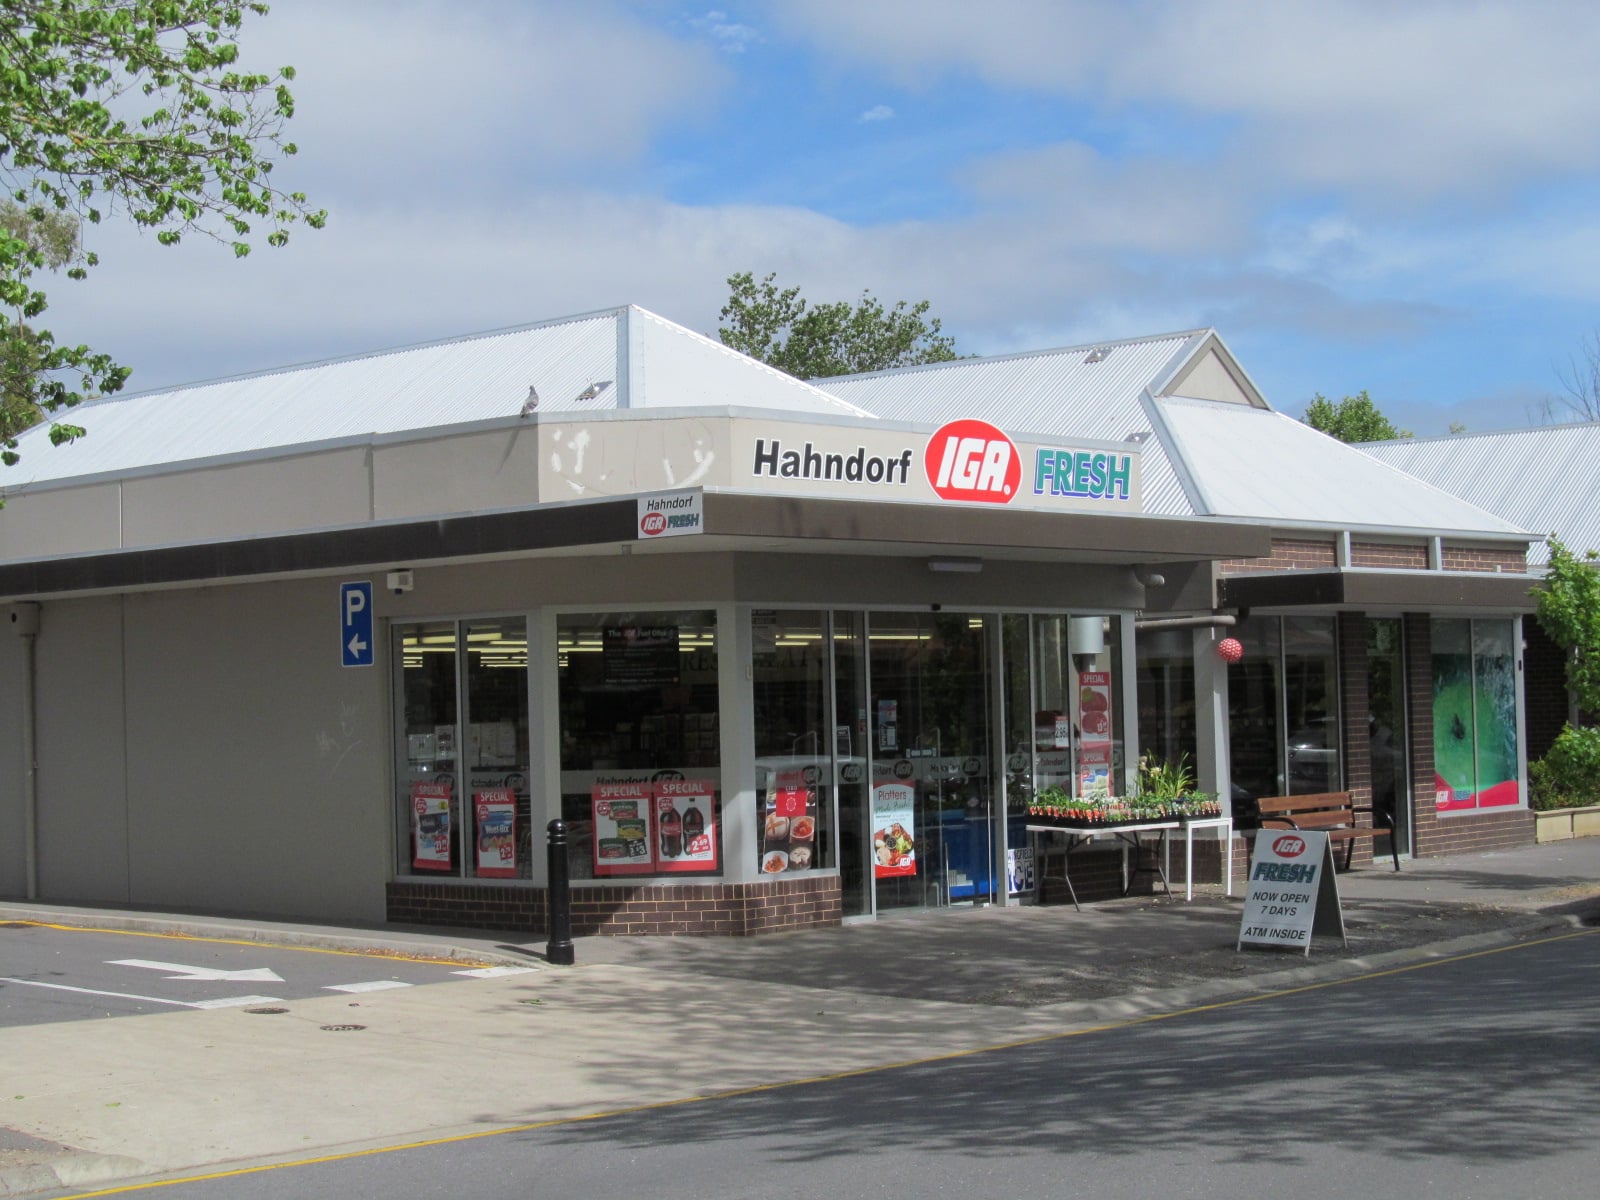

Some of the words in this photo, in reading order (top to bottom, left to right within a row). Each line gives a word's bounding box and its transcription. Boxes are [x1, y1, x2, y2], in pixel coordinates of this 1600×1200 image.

[752, 438, 912, 485] Hahndorf
[1034, 447, 1131, 500] FRESH
[647, 495, 693, 511] Hahndorf
[667, 513, 700, 529] FRESH
[346, 589, 366, 626] P
[1083, 673, 1105, 684] SPECIAL
[419, 785, 445, 797] SPECIAL
[601, 786, 642, 798] SPECIAL
[663, 783, 705, 794] SPECIAL
[480, 791, 509, 802] SPECIAL
[879, 790, 906, 801] Platters
[1254, 863, 1316, 884] FRESH
[1252, 891, 1278, 901] NOW
[1280, 893, 1310, 903] OPEN
[1261, 905, 1268, 914] 7
[1269, 905, 1297, 916] DAYS
[1244, 926, 1267, 937] ATM
[1269, 928, 1306, 940] INSIDE
